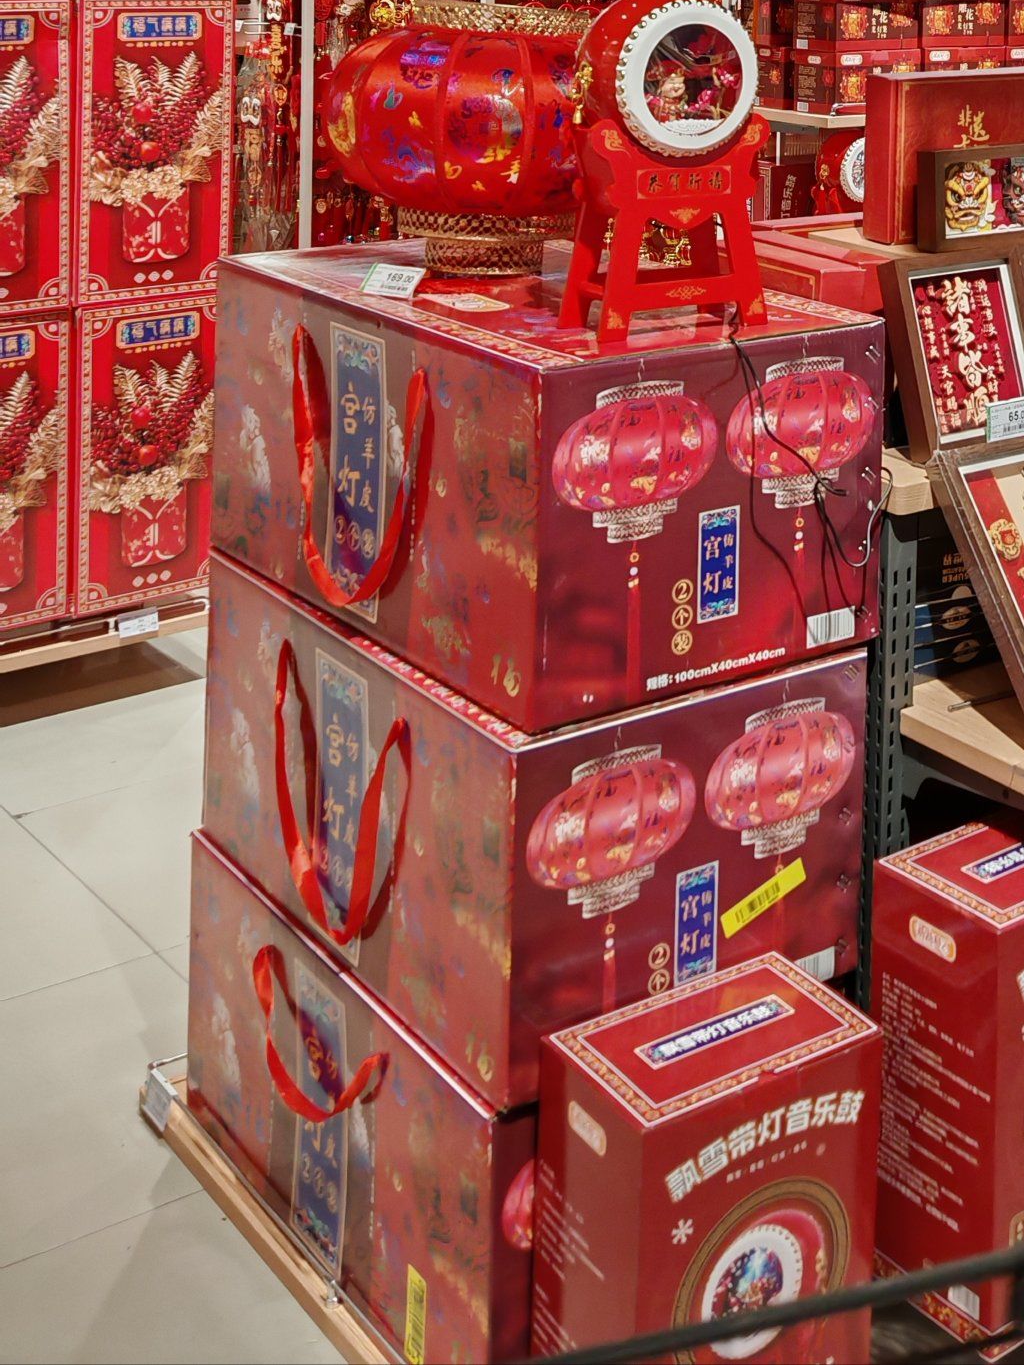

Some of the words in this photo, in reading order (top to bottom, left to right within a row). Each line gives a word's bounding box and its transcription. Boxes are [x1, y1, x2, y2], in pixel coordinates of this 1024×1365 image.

[336, 380, 362, 509] 宫灯
[702, 534, 722, 596] 宫灯
[664, 1089, 865, 1204] 飘雪带灯音乐鼓
